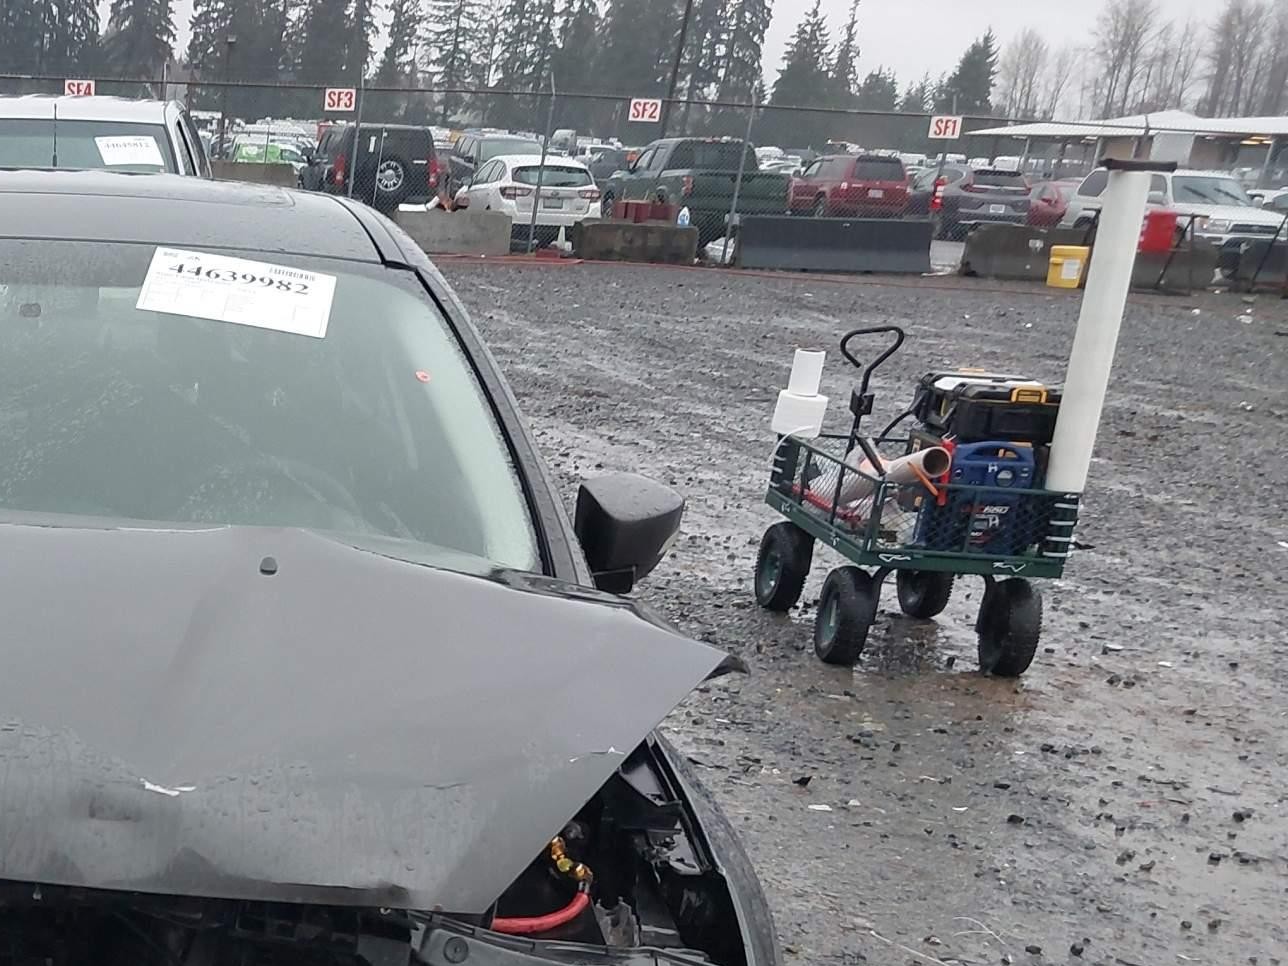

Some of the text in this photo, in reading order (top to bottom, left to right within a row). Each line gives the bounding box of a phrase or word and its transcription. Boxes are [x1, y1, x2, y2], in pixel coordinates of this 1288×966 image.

[67, 82, 92, 96] SF4
[327, 91, 353, 108] SF3
[632, 101, 658, 119] SF2
[934, 118, 957, 136] SF1
[169, 263, 310, 295] 44639982
